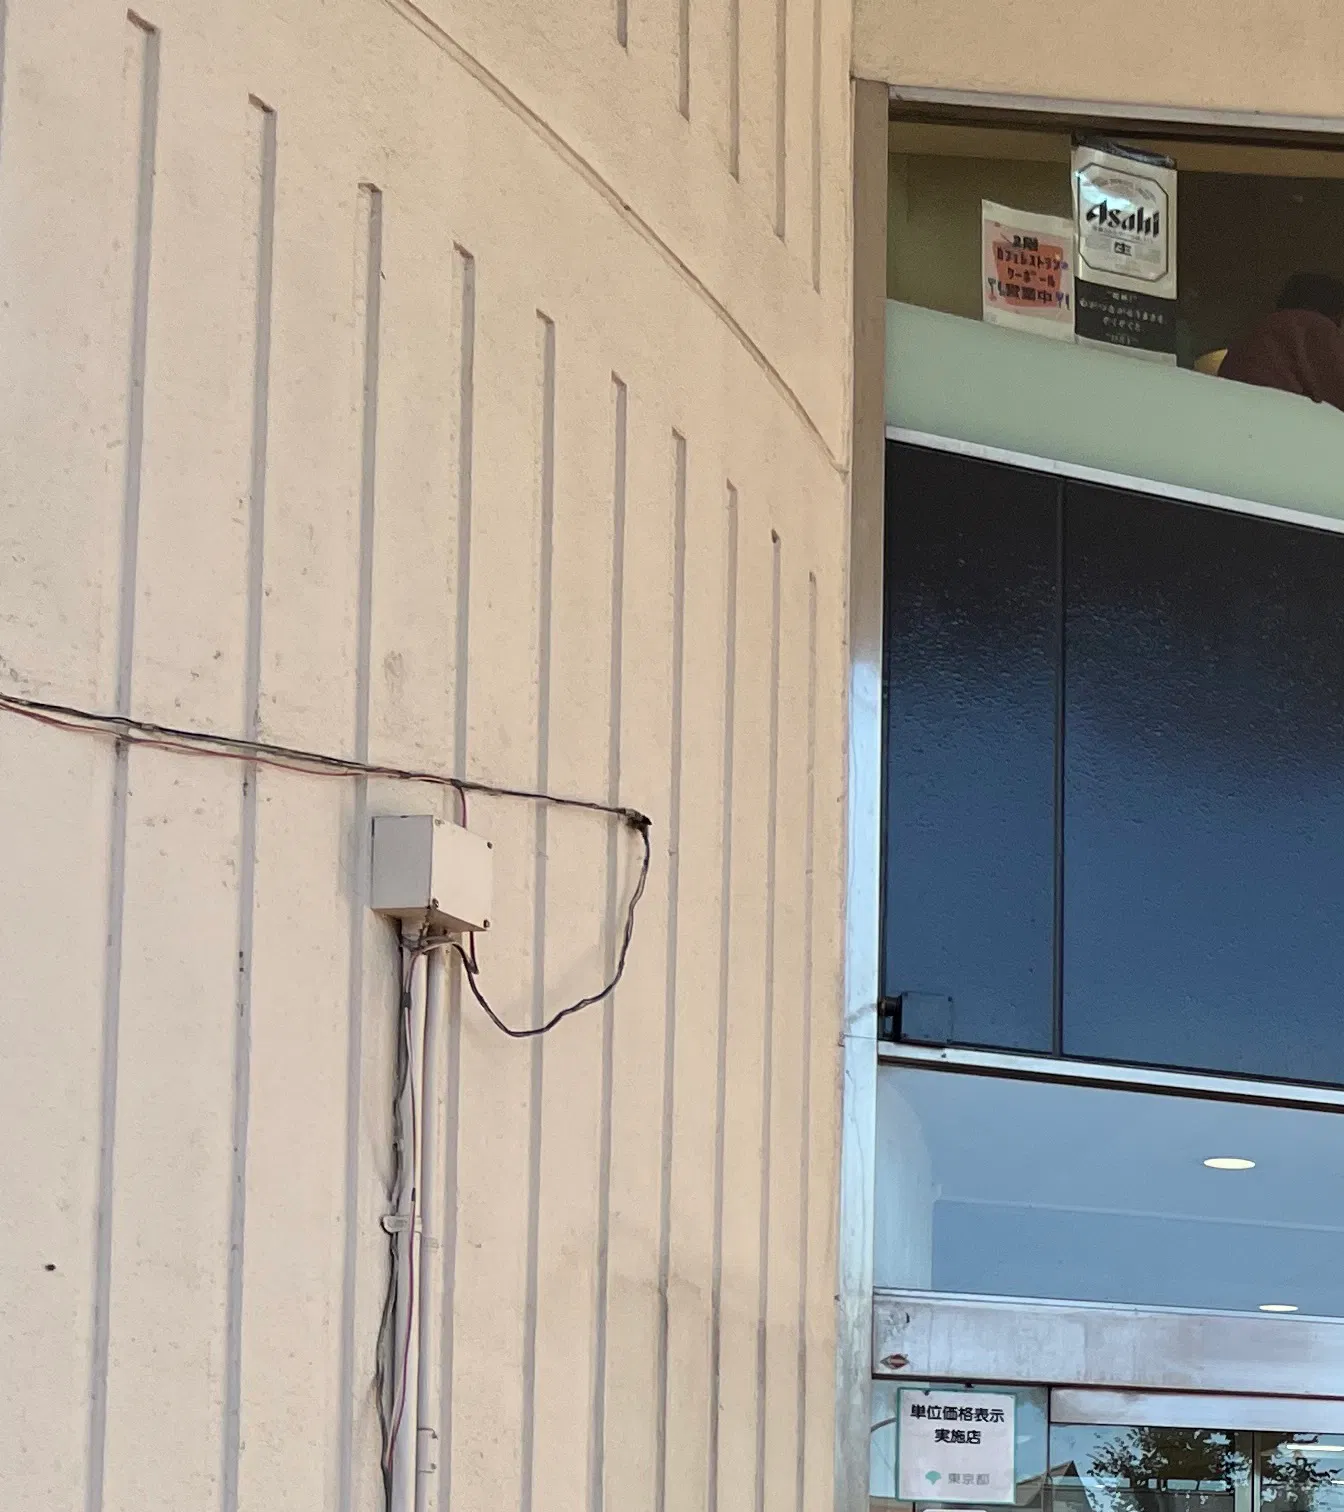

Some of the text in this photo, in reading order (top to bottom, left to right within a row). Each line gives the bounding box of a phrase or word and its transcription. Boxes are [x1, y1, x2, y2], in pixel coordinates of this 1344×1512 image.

[1086, 199, 1160, 238] Asahi
[910, 1404, 1005, 1423] 単位価格表示
[934, 1428, 981, 1445] 実施店
[948, 1473, 990, 1485] 東京都
